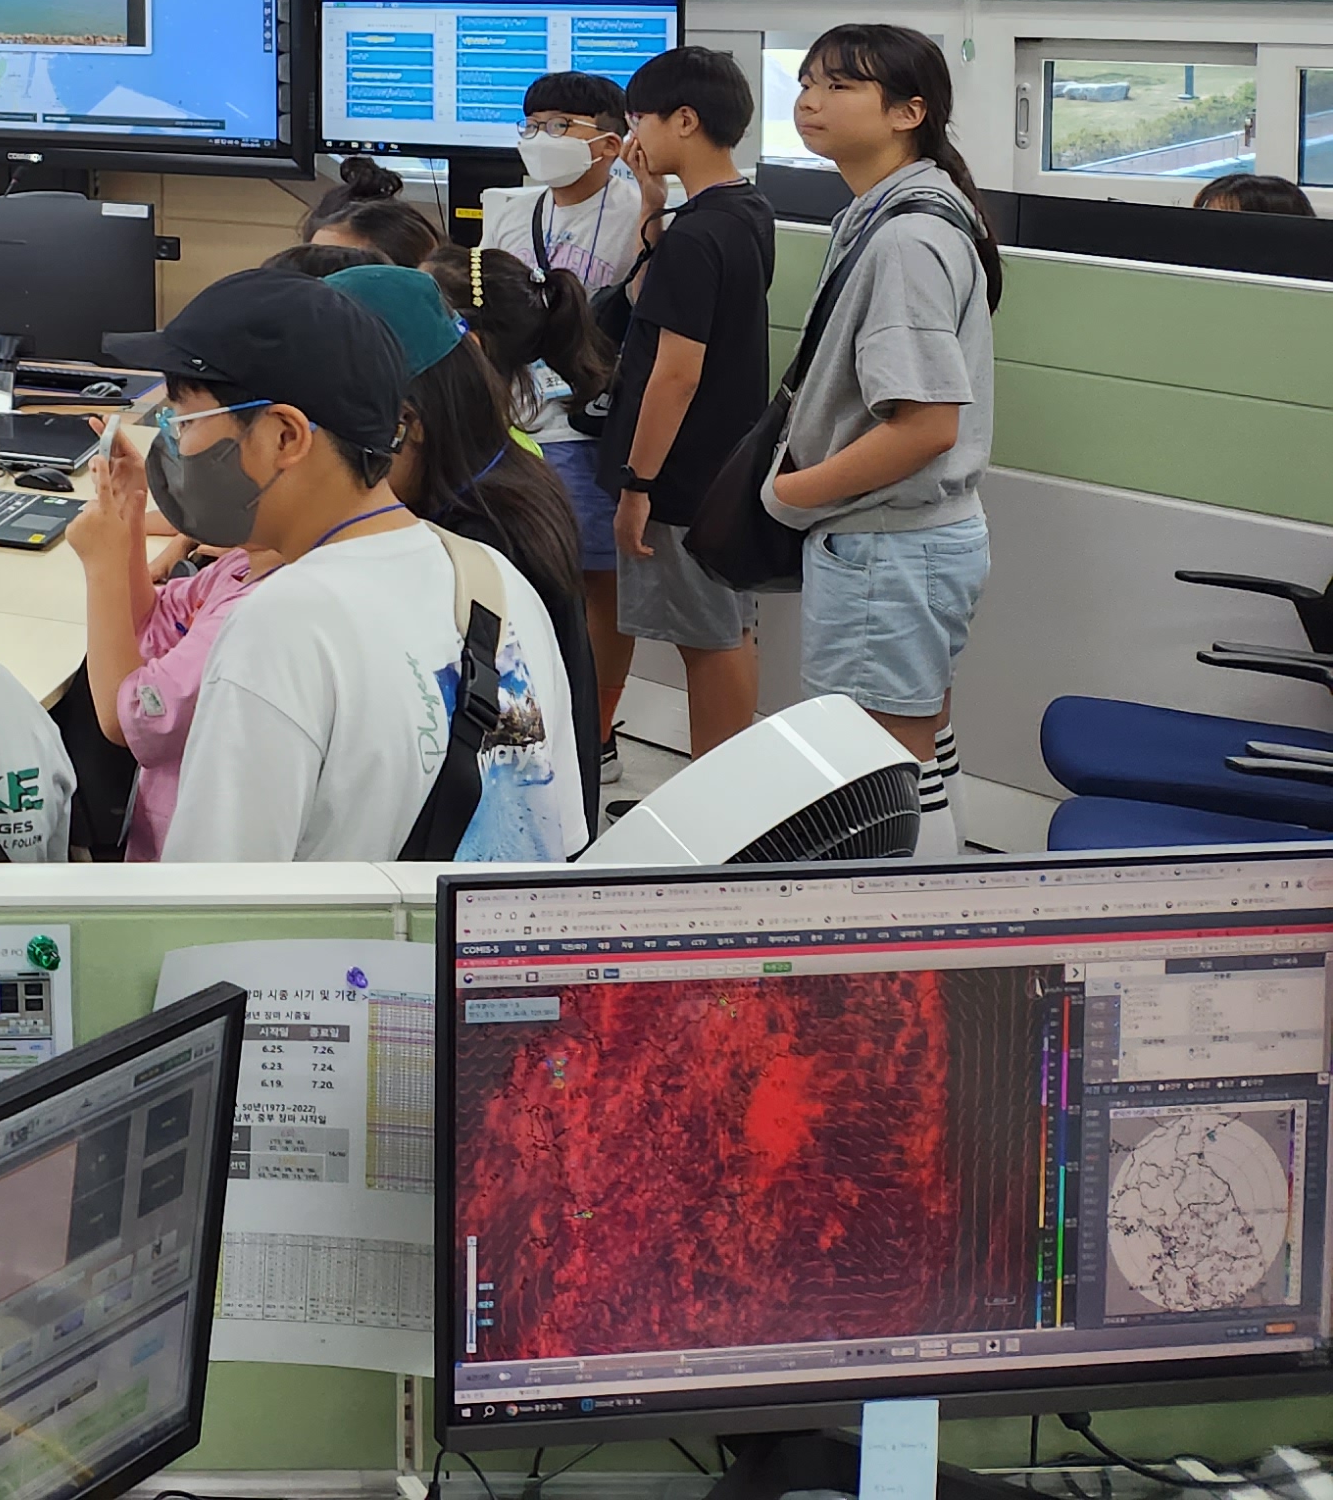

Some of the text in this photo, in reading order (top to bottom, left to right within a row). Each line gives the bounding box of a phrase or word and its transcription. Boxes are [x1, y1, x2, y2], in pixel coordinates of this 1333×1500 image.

[293, 990, 315, 1001] 시기
[319, 990, 330, 1002] 및
[334, 989, 357, 1002] 기간
[264, 1011, 282, 1021] 장마
[259, 1026, 340, 1039] 시작일 종료일
[311, 1046, 336, 1055] 7.26.
[311, 1063, 336, 1073] 7.24.
[311, 1080, 335, 1090] 7.20.
[299, 1114, 327, 1125] 시작일
